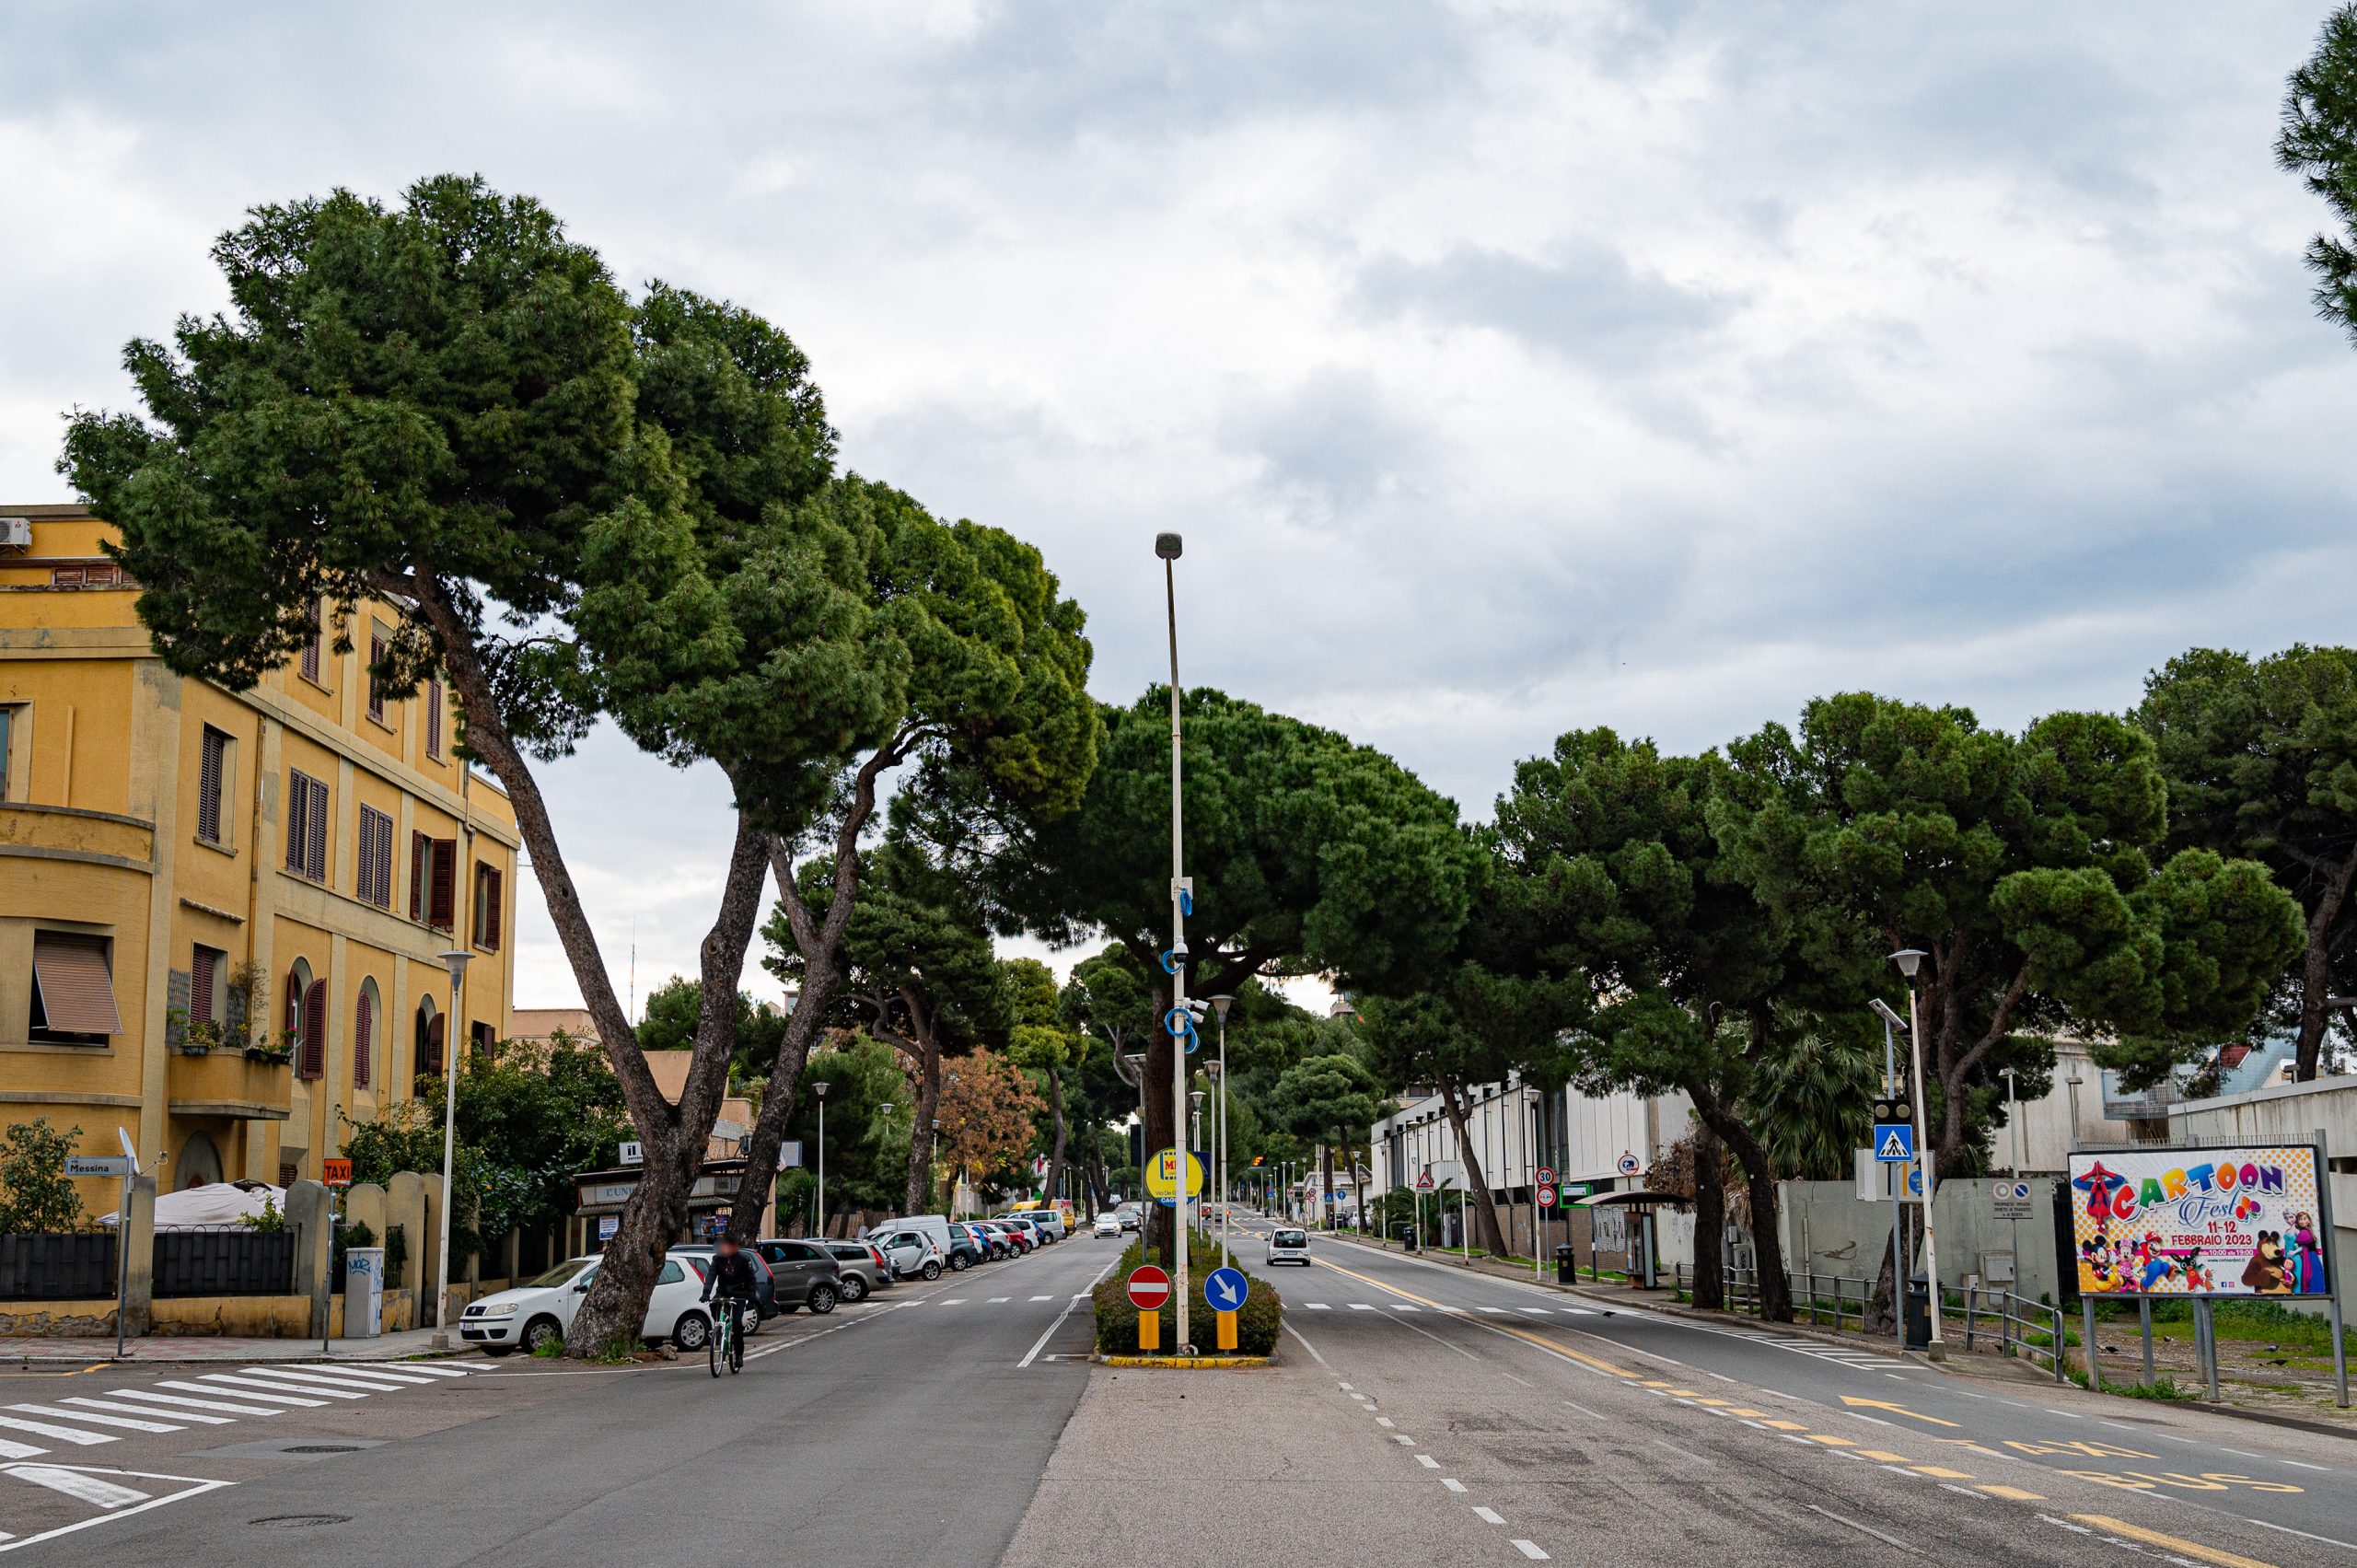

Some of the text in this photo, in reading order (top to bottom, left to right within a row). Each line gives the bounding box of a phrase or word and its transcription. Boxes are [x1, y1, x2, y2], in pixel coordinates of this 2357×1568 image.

[325, 1166, 350, 1179] TAXI
[1539, 1172, 1551, 1181] 30
[2111, 1162, 2285, 1221] CARTOON
[2178, 1186, 2243, 1227] Fest
[2207, 1220, 2237, 1233] 11-12
[2171, 1235, 2253, 1246] FEBBRAIO 2023
[1933, 1438, 2161, 1459] TAXI
[2055, 1469, 2305, 1493] BUS
